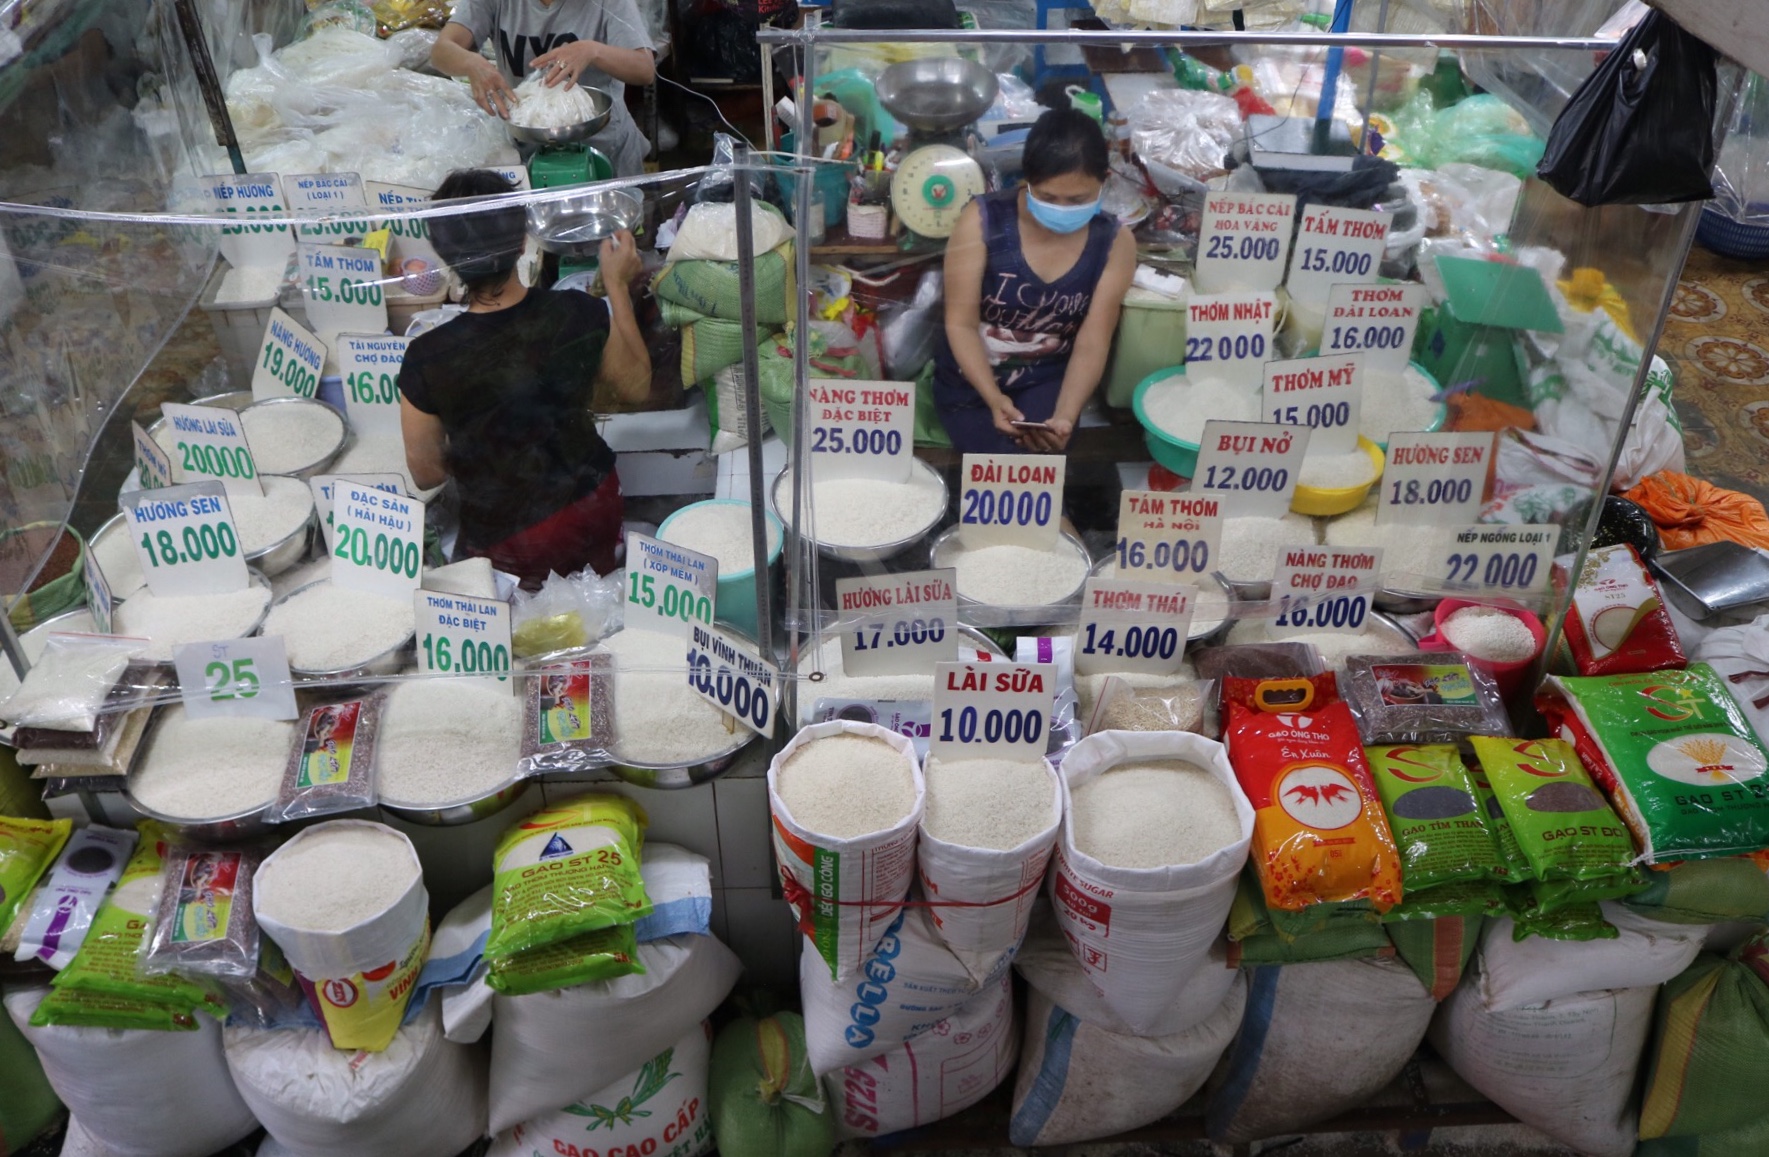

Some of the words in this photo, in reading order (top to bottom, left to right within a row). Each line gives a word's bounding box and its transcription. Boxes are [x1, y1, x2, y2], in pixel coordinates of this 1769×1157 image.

[500, 29, 579, 77] NY
[1304, 210, 1339, 236] TẤM
[1342, 219, 1387, 241] THƠM
[1206, 235, 1280, 261] 25.000
[1300, 247, 1373, 276] 15.000
[338, 256, 375, 273] THƠM
[306, 274, 383, 306] 15.000
[1351, 289, 1404, 303] THƠM
[1189, 300, 1230, 323] THƠM
[1233, 298, 1273, 326] NHẬT
[1367, 306, 1415, 318] LOAN
[1330, 325, 1405, 350] 16.000
[262, 341, 317, 399] 19.000
[1272, 368, 1323, 393] THƠM
[1327, 363, 1356, 387] MỸ
[347, 370, 402, 405] 16.00
[860, 389, 910, 407] THƠM
[822, 407, 855, 424] ĐẶC
[857, 408, 892, 425] BIỆT
[811, 427, 903, 456] 25.000
[1217, 434, 1257, 456] BỤI
[1392, 443, 1450, 466] HƯƠNG
[1452, 446, 1485, 465] SEN
[971, 459, 1002, 483] ĐÀI
[1008, 465, 1057, 485] LOAN
[1203, 465, 1288, 492] 12.000
[350, 490, 379, 507] ĐẶC
[381, 498, 410, 515] SẢN
[1389, 478, 1472, 506] 18.000
[134, 501, 188, 523] HƯƠNG
[190, 496, 222, 516] SEN
[962, 489, 1052, 527] 20.000
[1170, 498, 1219, 518] THƠM
[1143, 518, 1165, 529] HÀ
[1171, 518, 1200, 532] NỘI
[1456, 526, 1479, 543] NẾP
[1519, 532, 1544, 546] LOẠI
[141, 521, 237, 568] 18.000
[334, 523, 420, 580] 20.000
[639, 541, 664, 558] THƠM
[686, 558, 705, 571] LAN
[1116, 537, 1209, 574] 16.000
[1285, 550, 1327, 569] NÀNG
[1332, 552, 1375, 570] THƠM
[842, 586, 893, 610] HƯƠNG
[895, 580, 921, 605] LÀI
[923, 577, 953, 602] SỮA
[1290, 573, 1322, 591] CHỢ
[426, 594, 453, 610] THƠM
[479, 604, 497, 617] LAN
[628, 571, 712, 626] 15.000
[1093, 589, 1143, 610] THƠM
[1146, 591, 1187, 615] THÁI
[438, 613, 461, 630] ĐẶC
[463, 616, 487, 633] BIỆT
[853, 617, 945, 651] 17.000
[693, 626, 710, 651] BỤI
[1082, 622, 1178, 660] 14.000
[422, 632, 509, 681] 16.000
[205, 658, 260, 702] 25
[686, 647, 769, 729] 10.000
[947, 665, 987, 692] LÀI
[995, 668, 1044, 693] SỮA
[939, 705, 1043, 744] 10.000
[1580, 825, 1599, 837] ST
[568, 855, 593, 868] ST
[597, 849, 622, 866] 25
[1058, 854, 1078, 885] WHITE
[1079, 879, 1115, 899] SUGAR
[1062, 883, 1098, 914] 500g
[607, 1137, 657, 1157] CAO
[662, 1097, 700, 1144] CẤP
